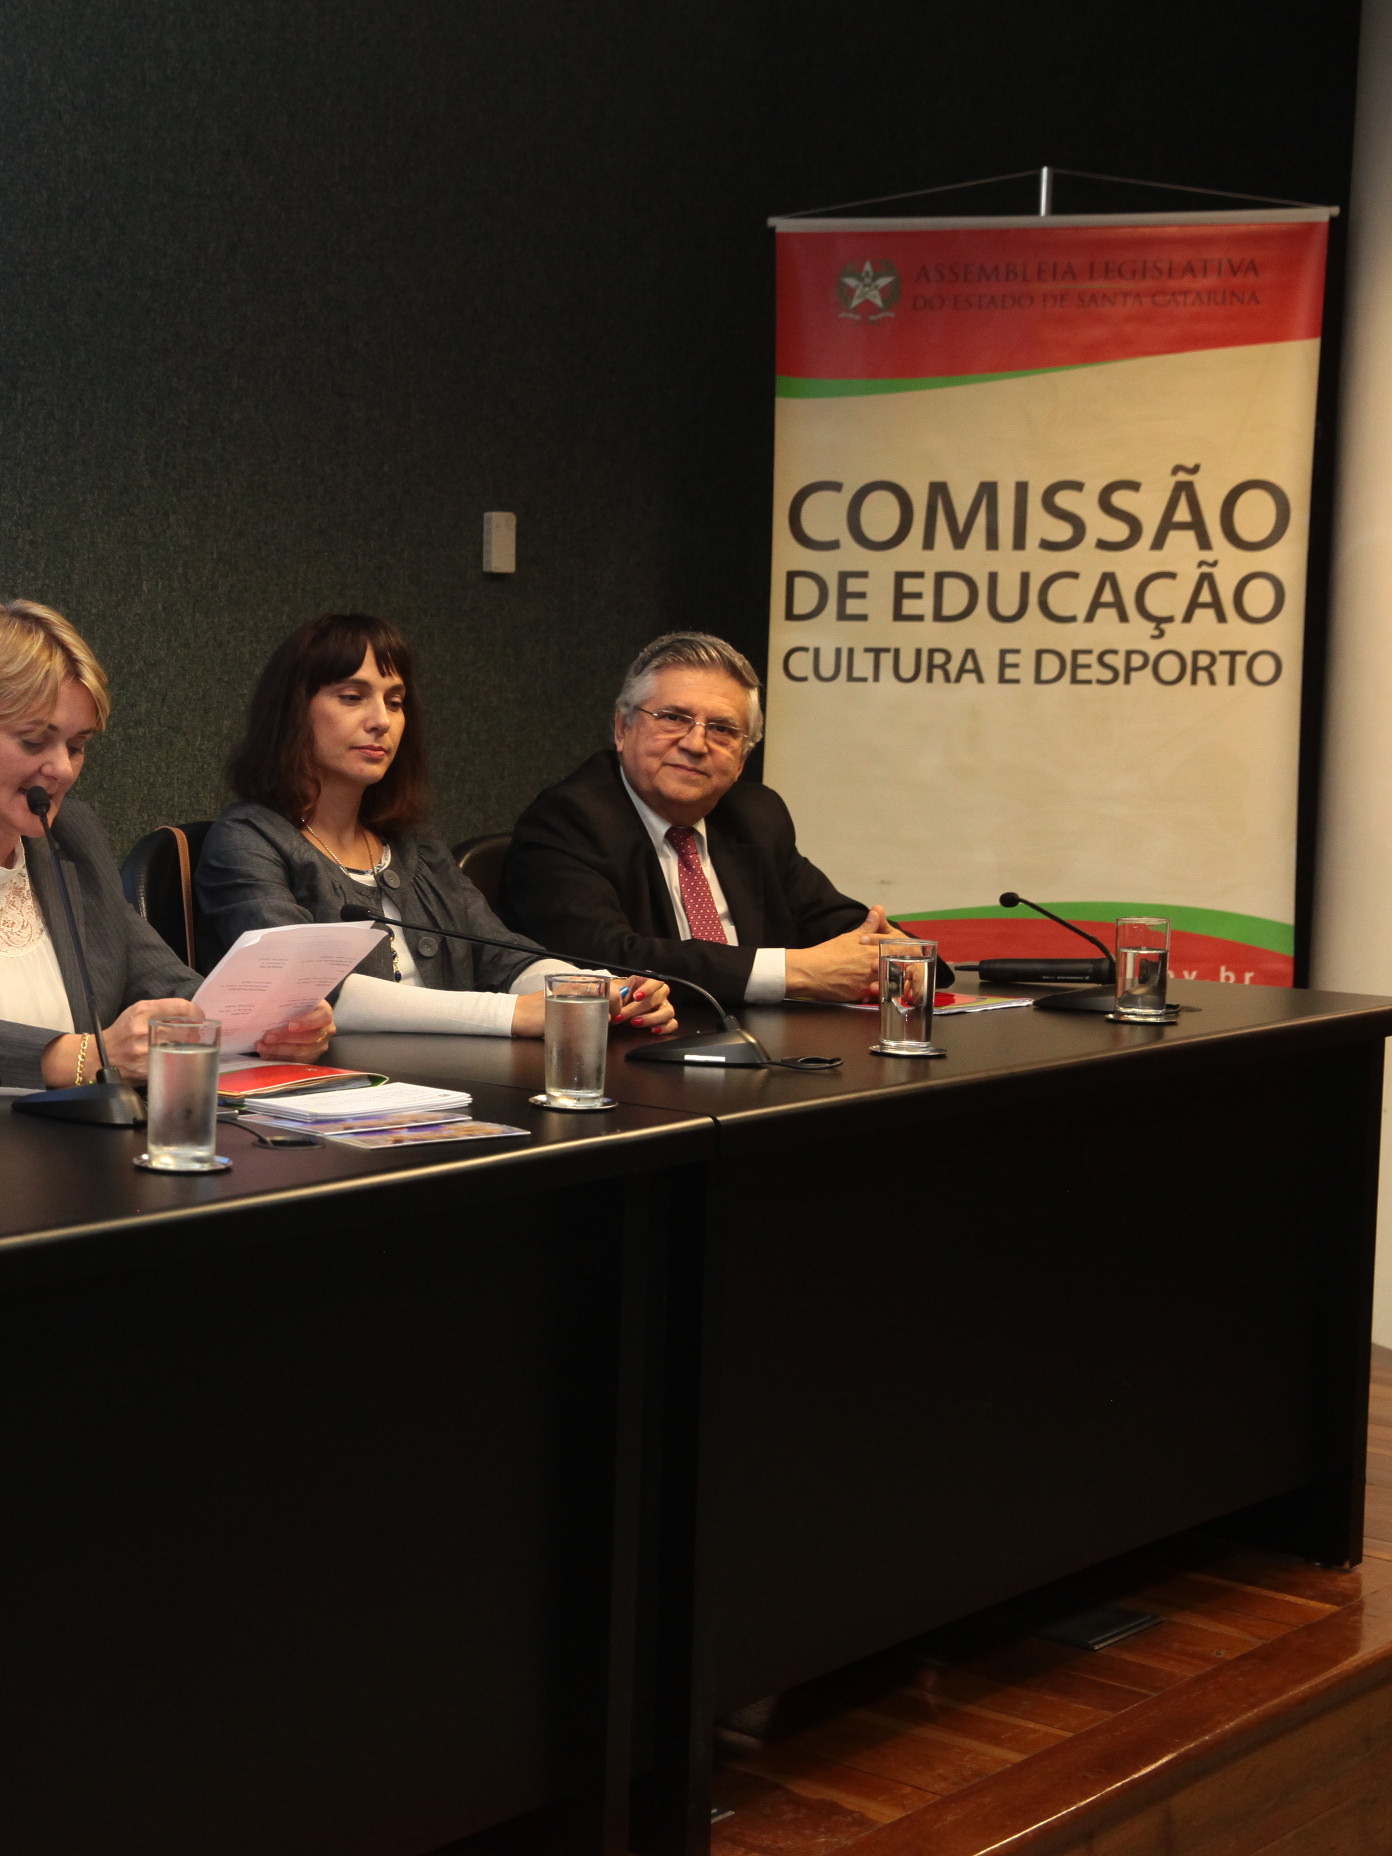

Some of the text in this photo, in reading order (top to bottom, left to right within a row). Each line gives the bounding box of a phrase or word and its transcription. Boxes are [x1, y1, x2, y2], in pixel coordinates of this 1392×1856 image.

[914, 257, 1261, 283] ASSEMBLEIA LEGISLATIVA
[912, 287, 1261, 311] DO ESTADO DE SANTA CATARINA
[786, 463, 1292, 552] COMISSÃO
[783, 559, 1287, 639] DE EDUCAÇÃO
[781, 645, 1284, 687] CULTURA E DESPORTO
